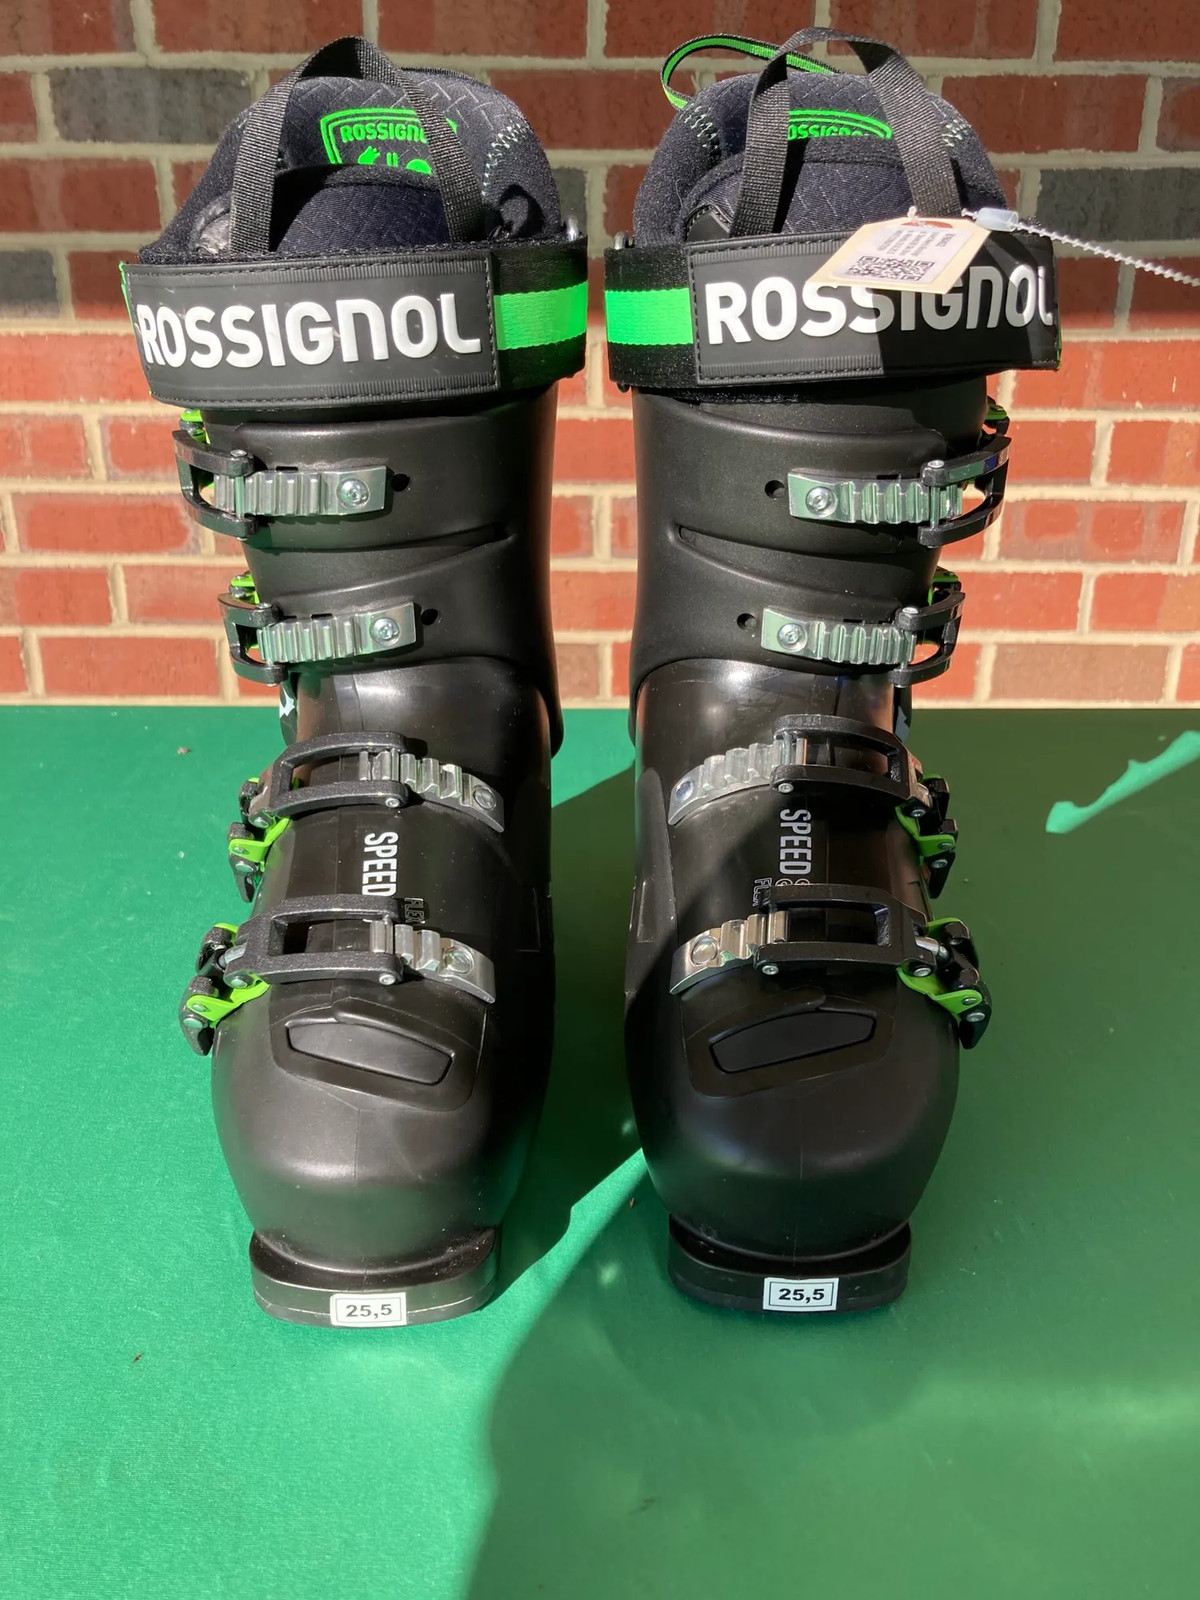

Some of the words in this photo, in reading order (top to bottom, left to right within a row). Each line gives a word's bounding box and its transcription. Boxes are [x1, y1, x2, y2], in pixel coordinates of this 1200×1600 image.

[787, 124, 869, 141] OSSIGN
[137, 293, 482, 369] ROSSIGNOL
[705, 264, 1053, 345] ROSSIGNOL
[362, 831, 399, 897] SPEED
[779, 809, 812, 875] SPEED
[345, 1303, 392, 1320] 25,5
[778, 1288, 825, 1304] 25,5
